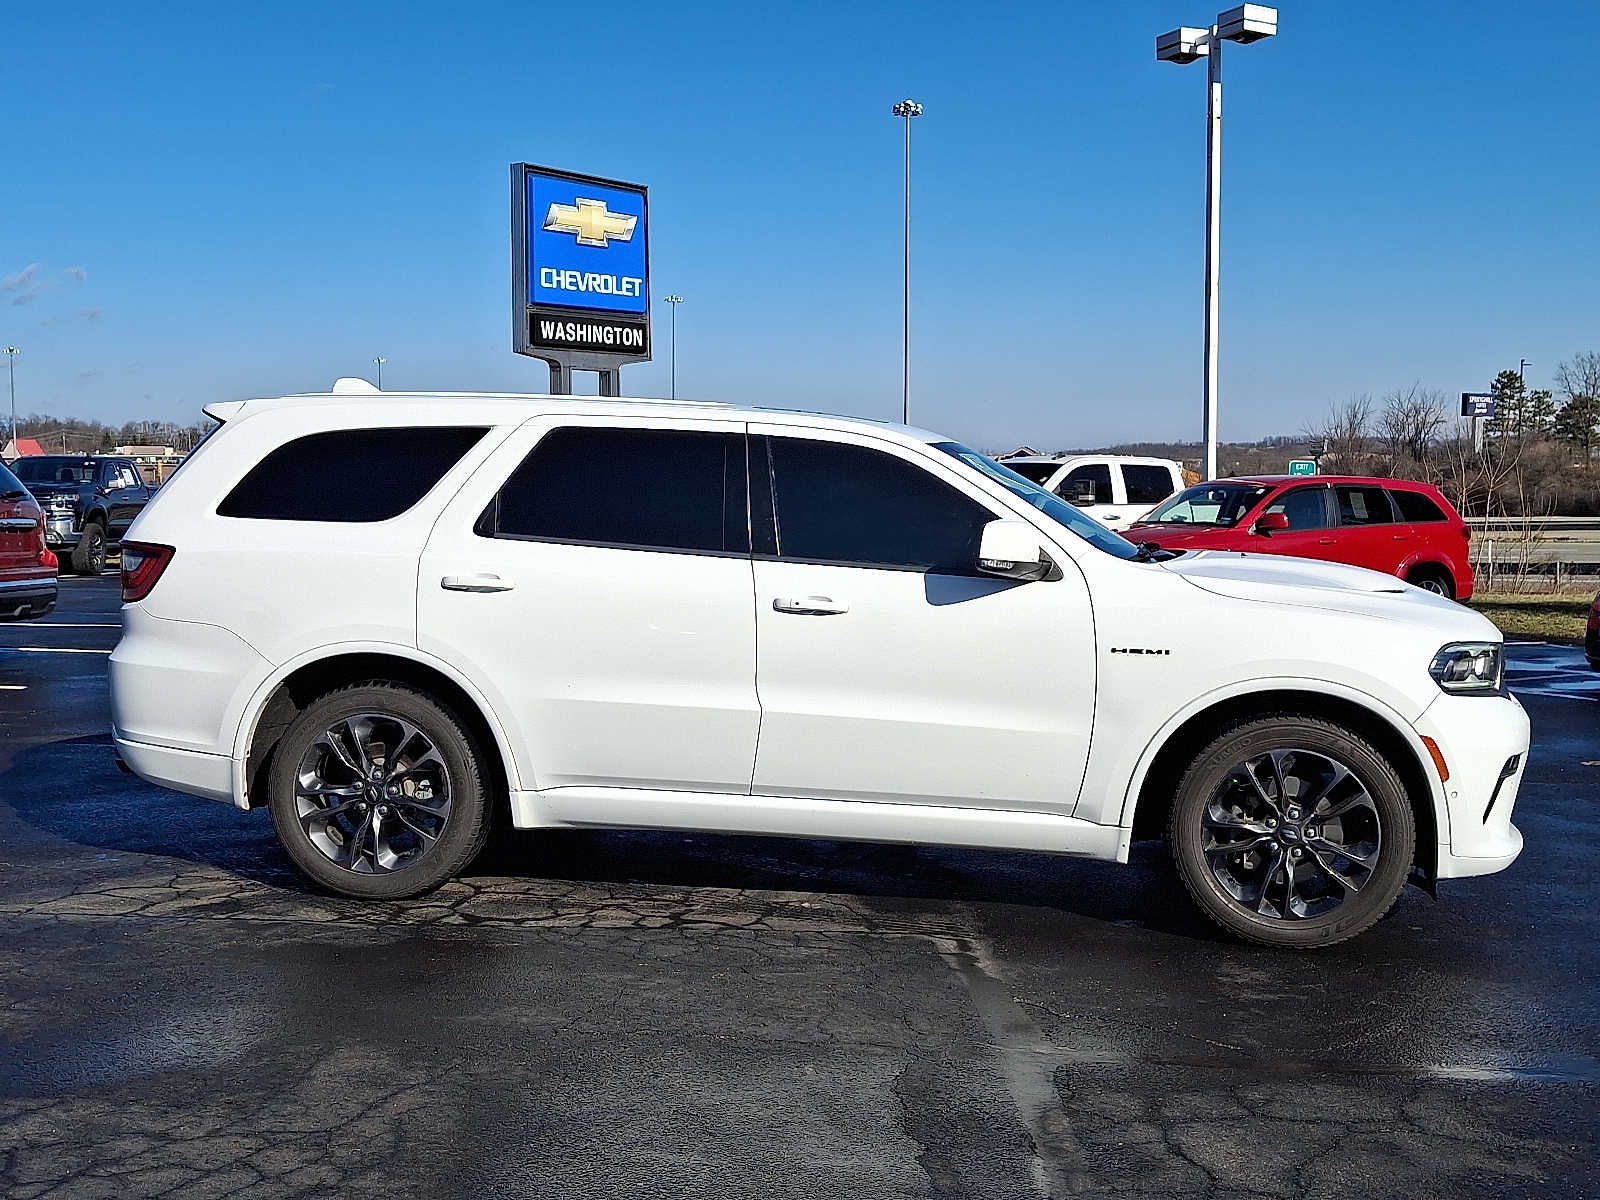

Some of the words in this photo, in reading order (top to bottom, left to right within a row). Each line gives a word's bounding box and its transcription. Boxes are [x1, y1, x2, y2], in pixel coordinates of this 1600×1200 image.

[540, 267, 643, 297] CHEVROLET
[540, 320, 643, 347] WASHINGTON
[1110, 647, 1170, 656] HEMI
